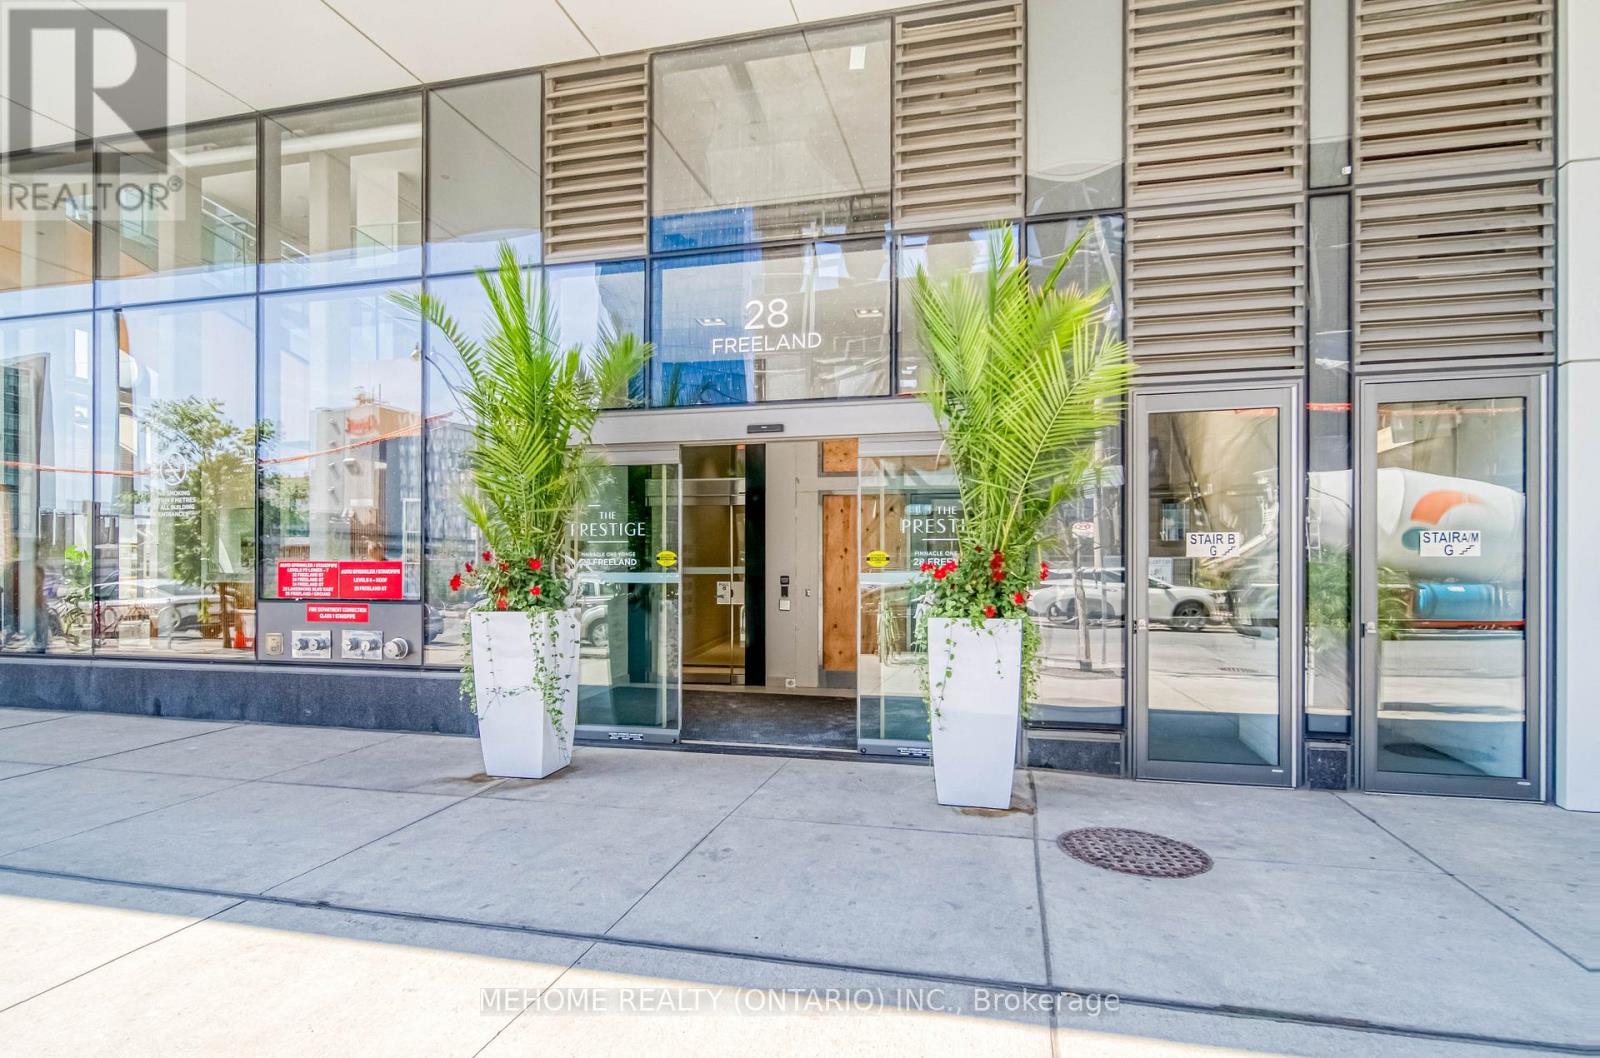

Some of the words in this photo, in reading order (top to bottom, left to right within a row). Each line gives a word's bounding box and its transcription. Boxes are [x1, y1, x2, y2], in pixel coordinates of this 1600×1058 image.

[744, 298, 789, 330] 28
[712, 332, 822, 355] FREELAND
[599, 511, 616, 520] THE
[936, 505, 957, 515] THE
[1190, 534, 1224, 545] STAIR
[1228, 534, 1236, 545] B
[1209, 545, 1217, 556] G
[1444, 544, 1454, 556] G
